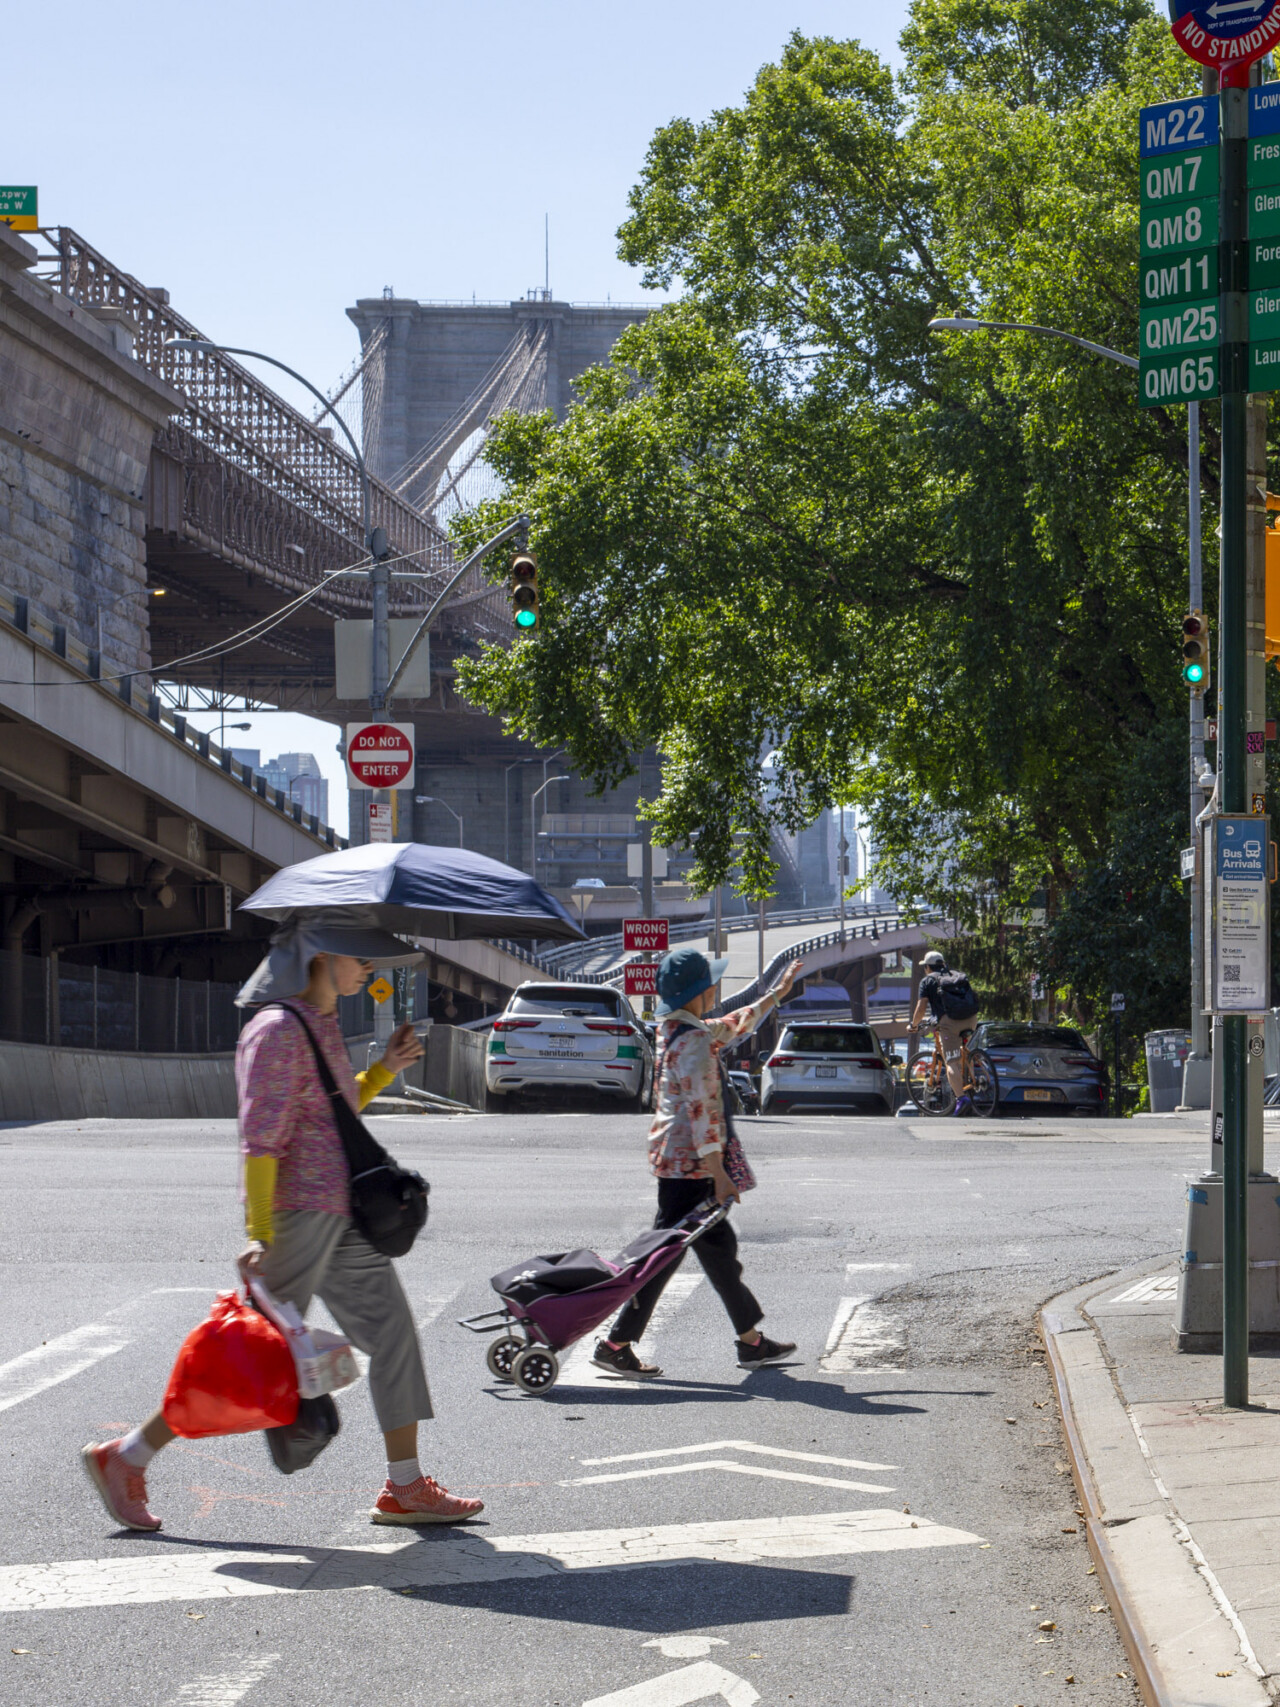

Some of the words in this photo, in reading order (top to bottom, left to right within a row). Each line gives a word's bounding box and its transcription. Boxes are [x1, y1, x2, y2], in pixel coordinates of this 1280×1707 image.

[1181, 20, 1206, 49] NO
[1146, 104, 1205, 149] M22
[1146, 155, 1202, 200] QM7
[0, 191, 28, 200] xpwy
[1254, 193, 1280, 212] Glen
[1146, 206, 1202, 249] QM8
[1145, 255, 1209, 300] QM11
[1146, 304, 1217, 350] QM25
[1145, 355, 1214, 400] QM65
[359, 737, 375, 747] DO
[379, 737, 402, 747] NOT
[362, 765, 399, 776] ENTER
[1223, 848, 1243, 858] Bus
[1222, 859, 1262, 869] Arrivals
[625, 923, 667, 934] WRONG
[634, 936, 658, 947] WAY
[626, 967, 659, 978] WRON
[634, 980, 658, 991] WAY
[538, 1048, 584, 1058] sanitation
